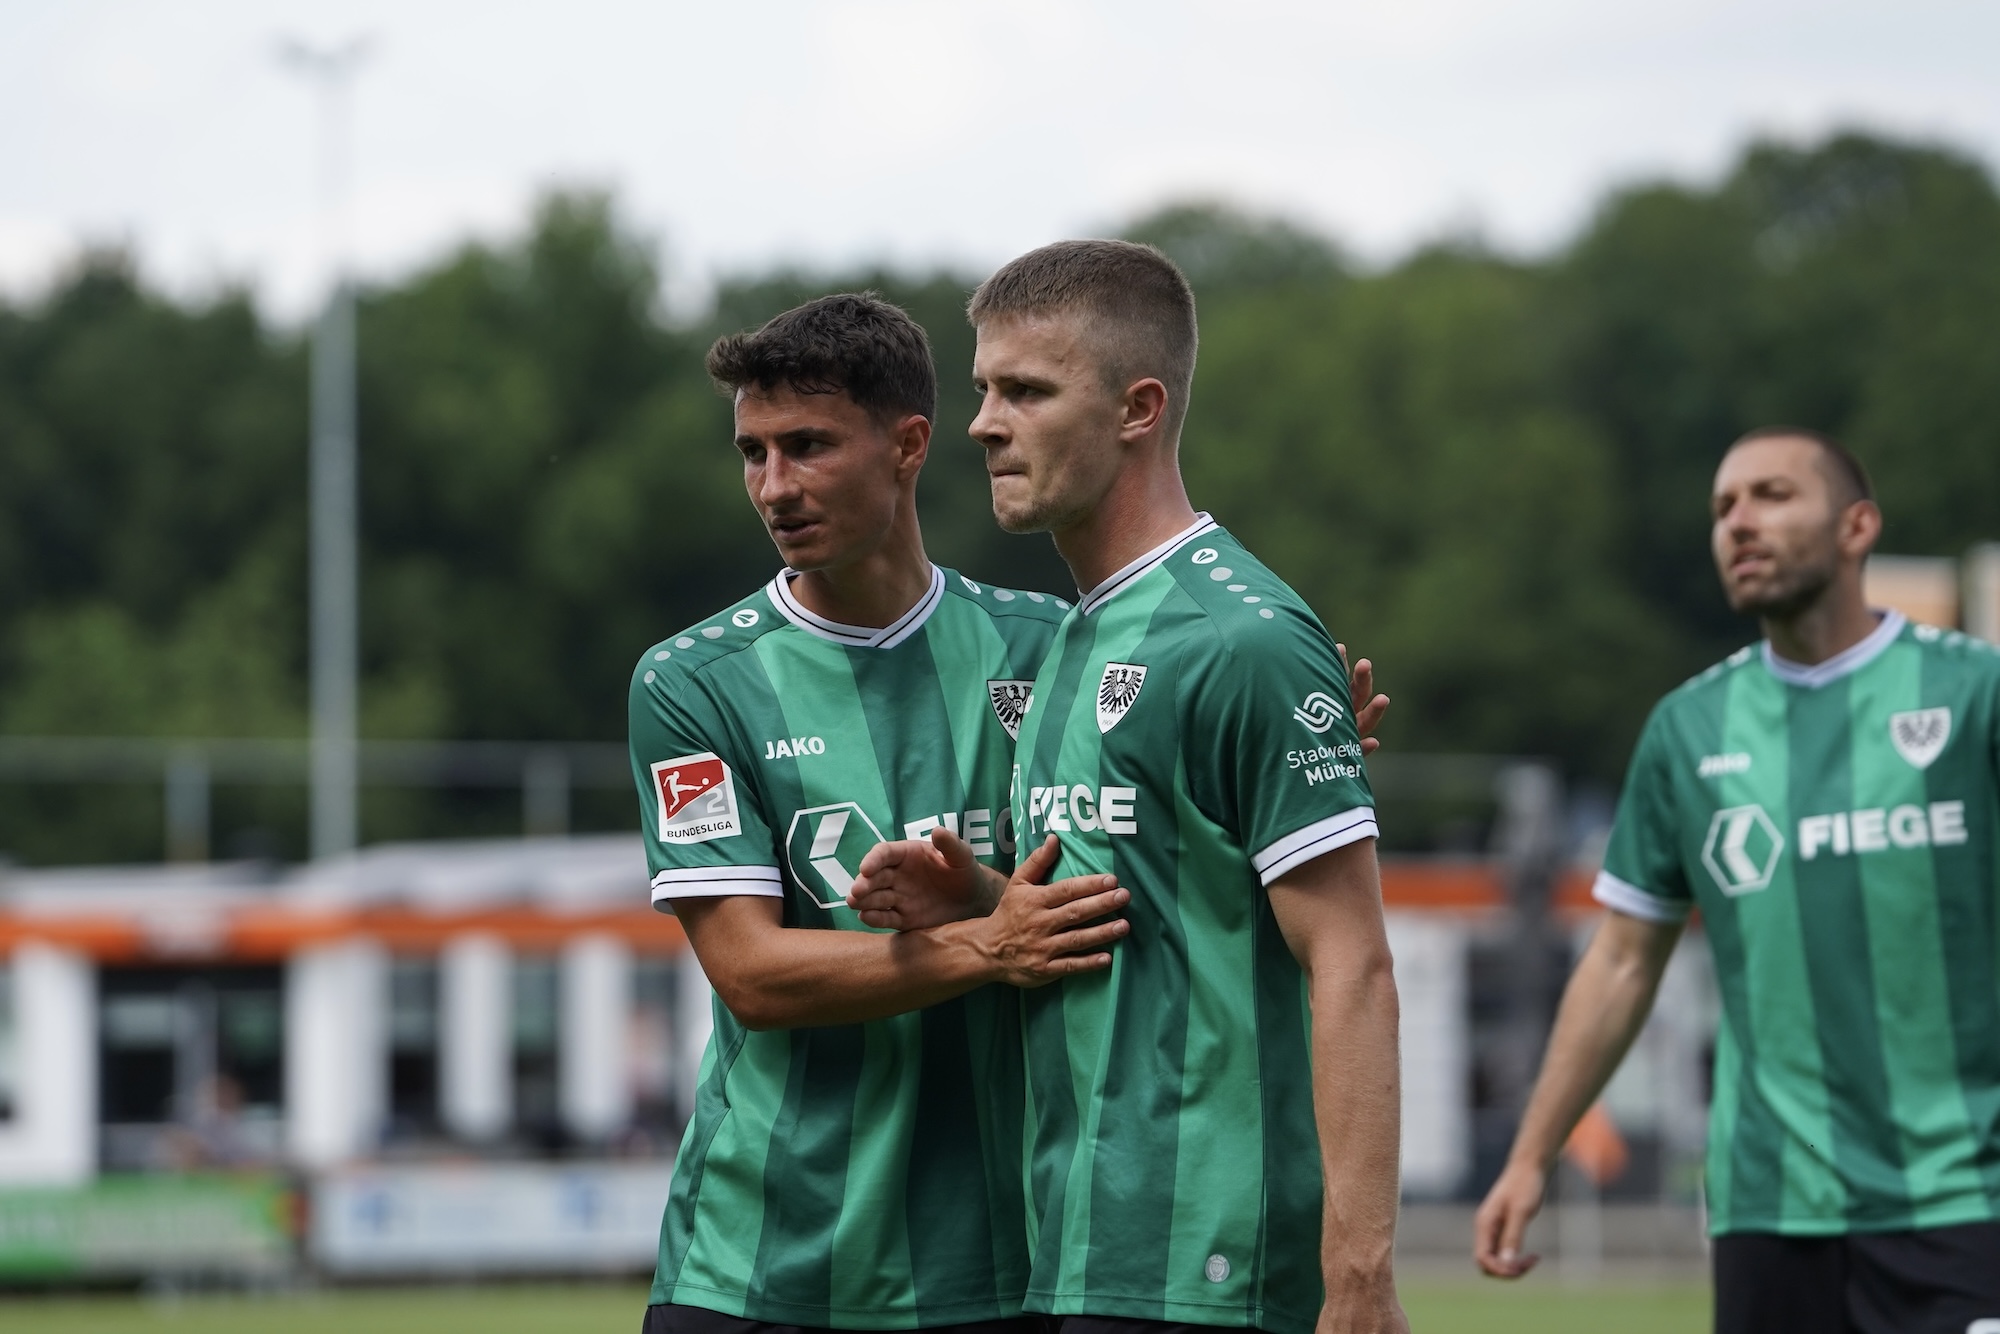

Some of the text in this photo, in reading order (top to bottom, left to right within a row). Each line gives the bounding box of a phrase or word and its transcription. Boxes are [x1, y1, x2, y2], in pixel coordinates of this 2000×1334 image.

[765, 737, 826, 760] JAKO
[1286, 740, 1362, 769] Stadwerke
[705, 787, 726, 814] 2
[1029, 784, 1137, 835] FIEGE
[667, 821, 733, 838] BUNDESLIGA
[1798, 800, 1968, 861] FIEGE
